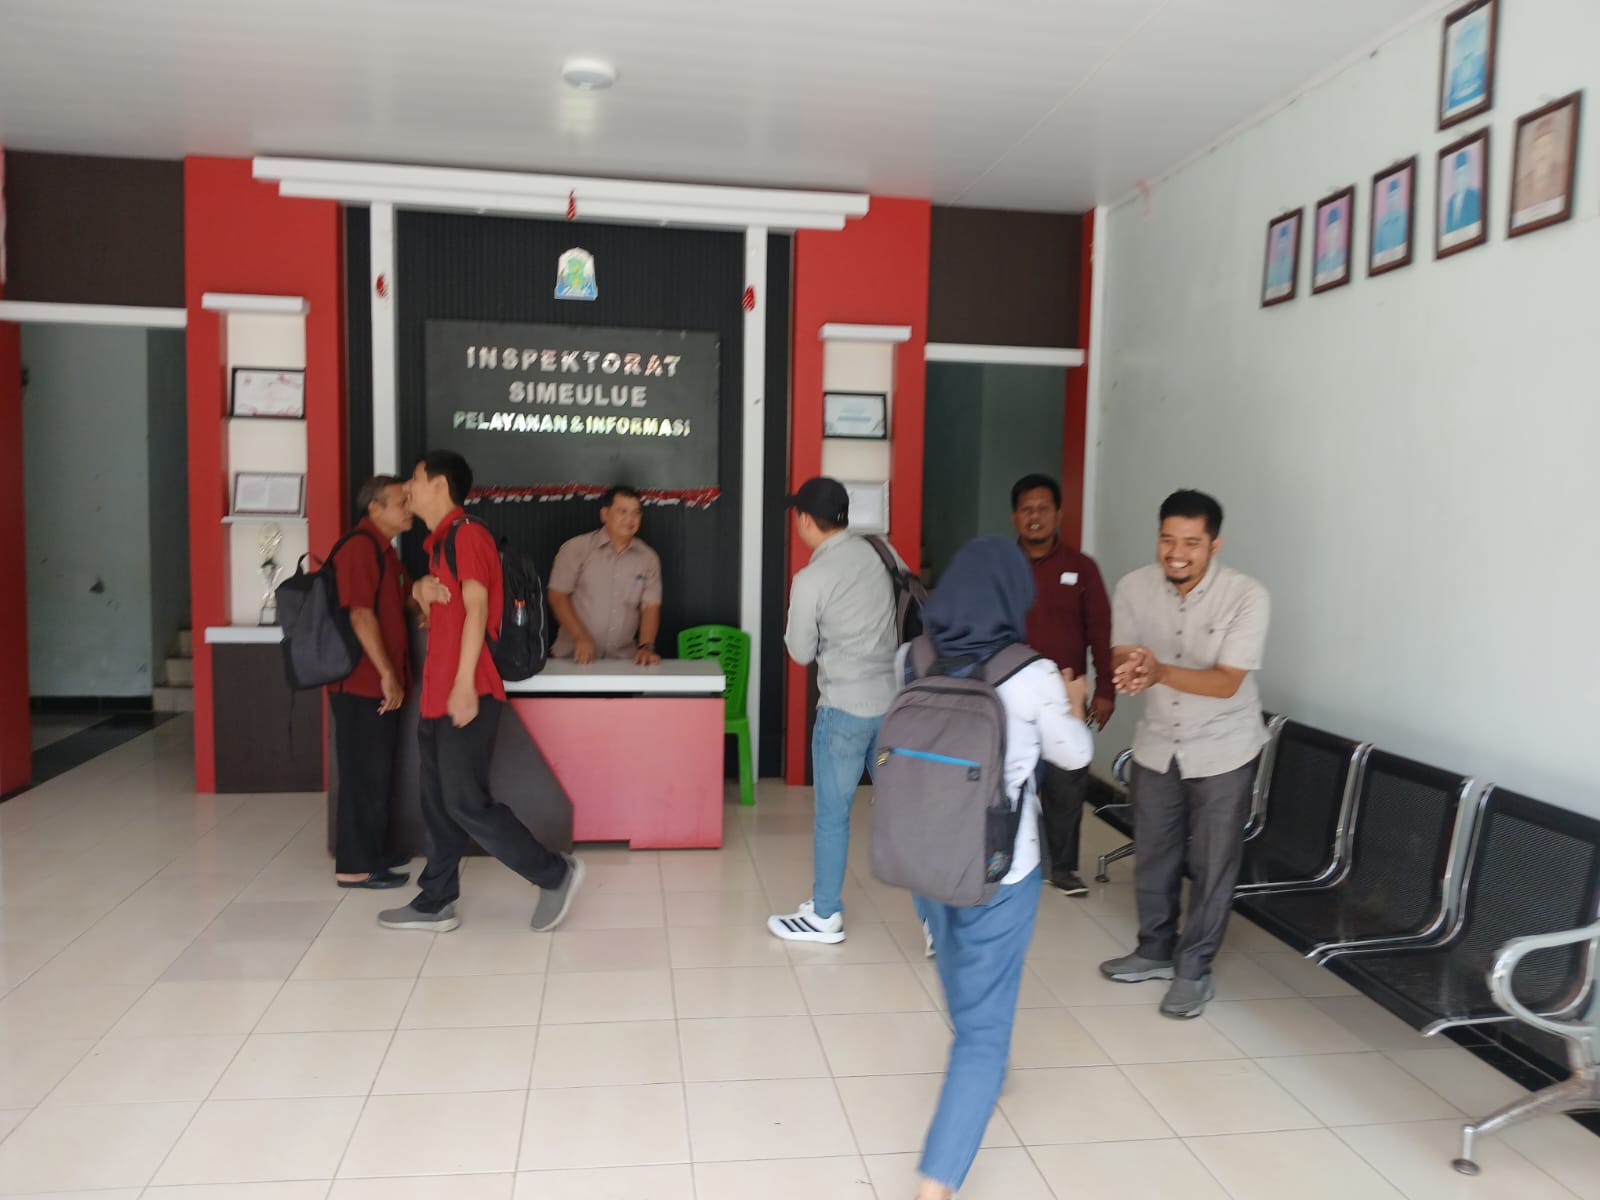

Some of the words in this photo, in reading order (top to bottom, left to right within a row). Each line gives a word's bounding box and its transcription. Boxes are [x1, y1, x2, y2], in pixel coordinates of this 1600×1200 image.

[467, 346, 681, 377] INSPEKTORAT
[509, 381, 647, 407] SIMEULUE
[453, 411, 568, 433] PELAYANAN
[570, 415, 584, 433] &
[586, 416, 690, 437] INFORMASI
